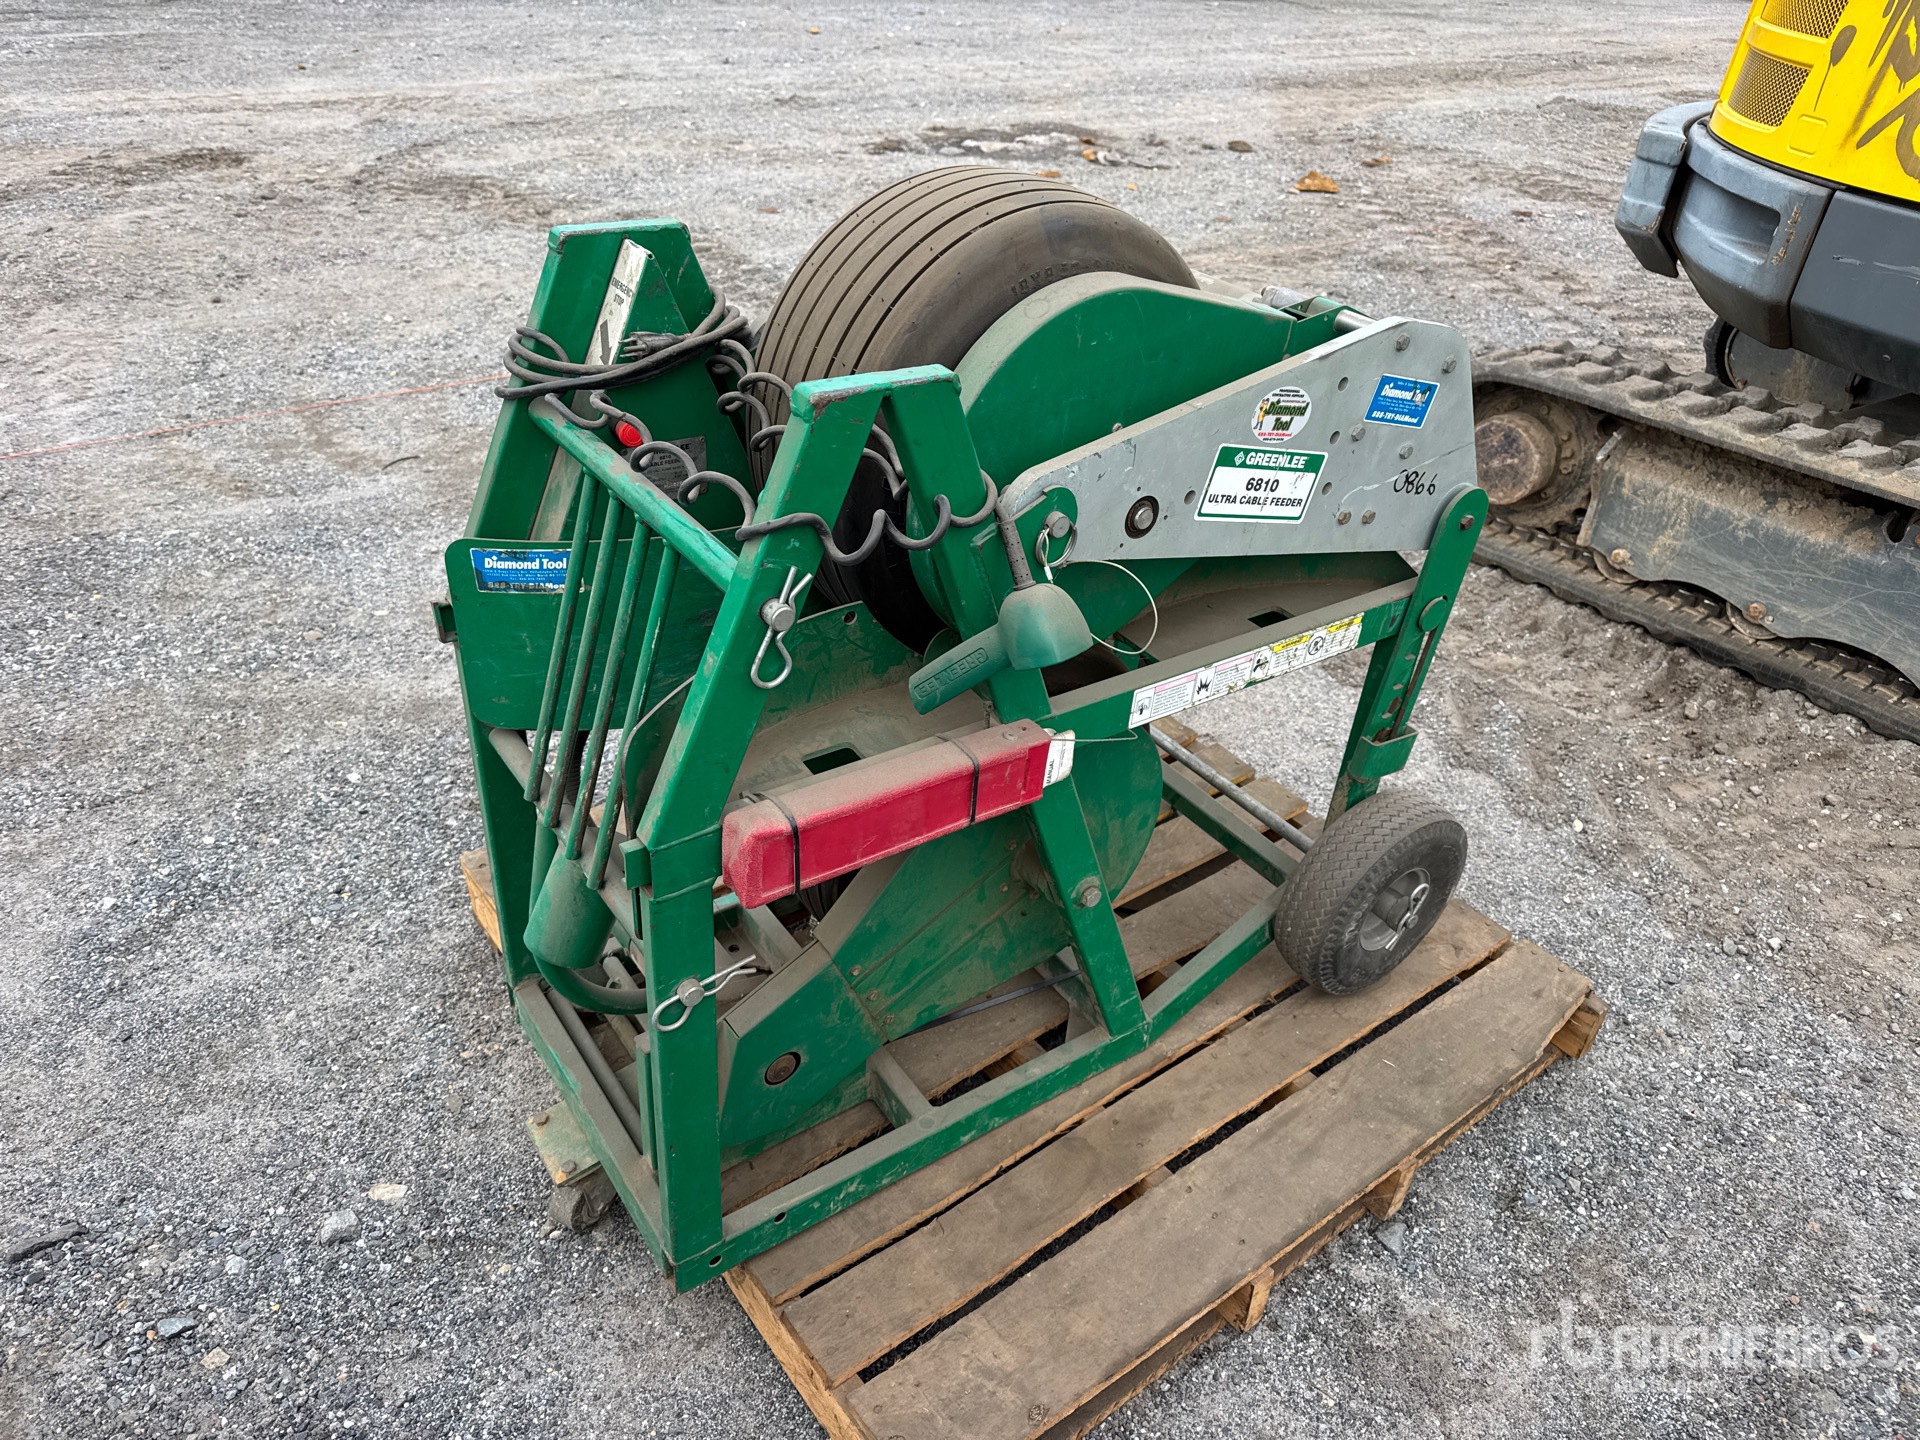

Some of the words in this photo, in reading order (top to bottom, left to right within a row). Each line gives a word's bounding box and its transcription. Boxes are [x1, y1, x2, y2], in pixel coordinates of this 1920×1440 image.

[611, 276, 633, 298] EMERGENC
[613, 293, 624, 307] STOP
[1381, 382, 1416, 401] Diamond
[1265, 398, 1310, 416] Diamond
[1271, 416, 1294, 431] Tool
[1246, 452, 1308, 469] GREENLEE
[1245, 477, 1280, 493] 6810
[1208, 493, 1237, 504] ULTRA
[1239, 495, 1269, 506] CABLE
[1270, 497, 1303, 508] FEEDER
[484, 555, 540, 569] Diamond
[541, 557, 567, 570] Tool
[487, 582, 565, 590] 888-TRY-DIAMon
[917, 649, 988, 698] GREENLEE
[1045, 759, 1055, 785] MANUAL
